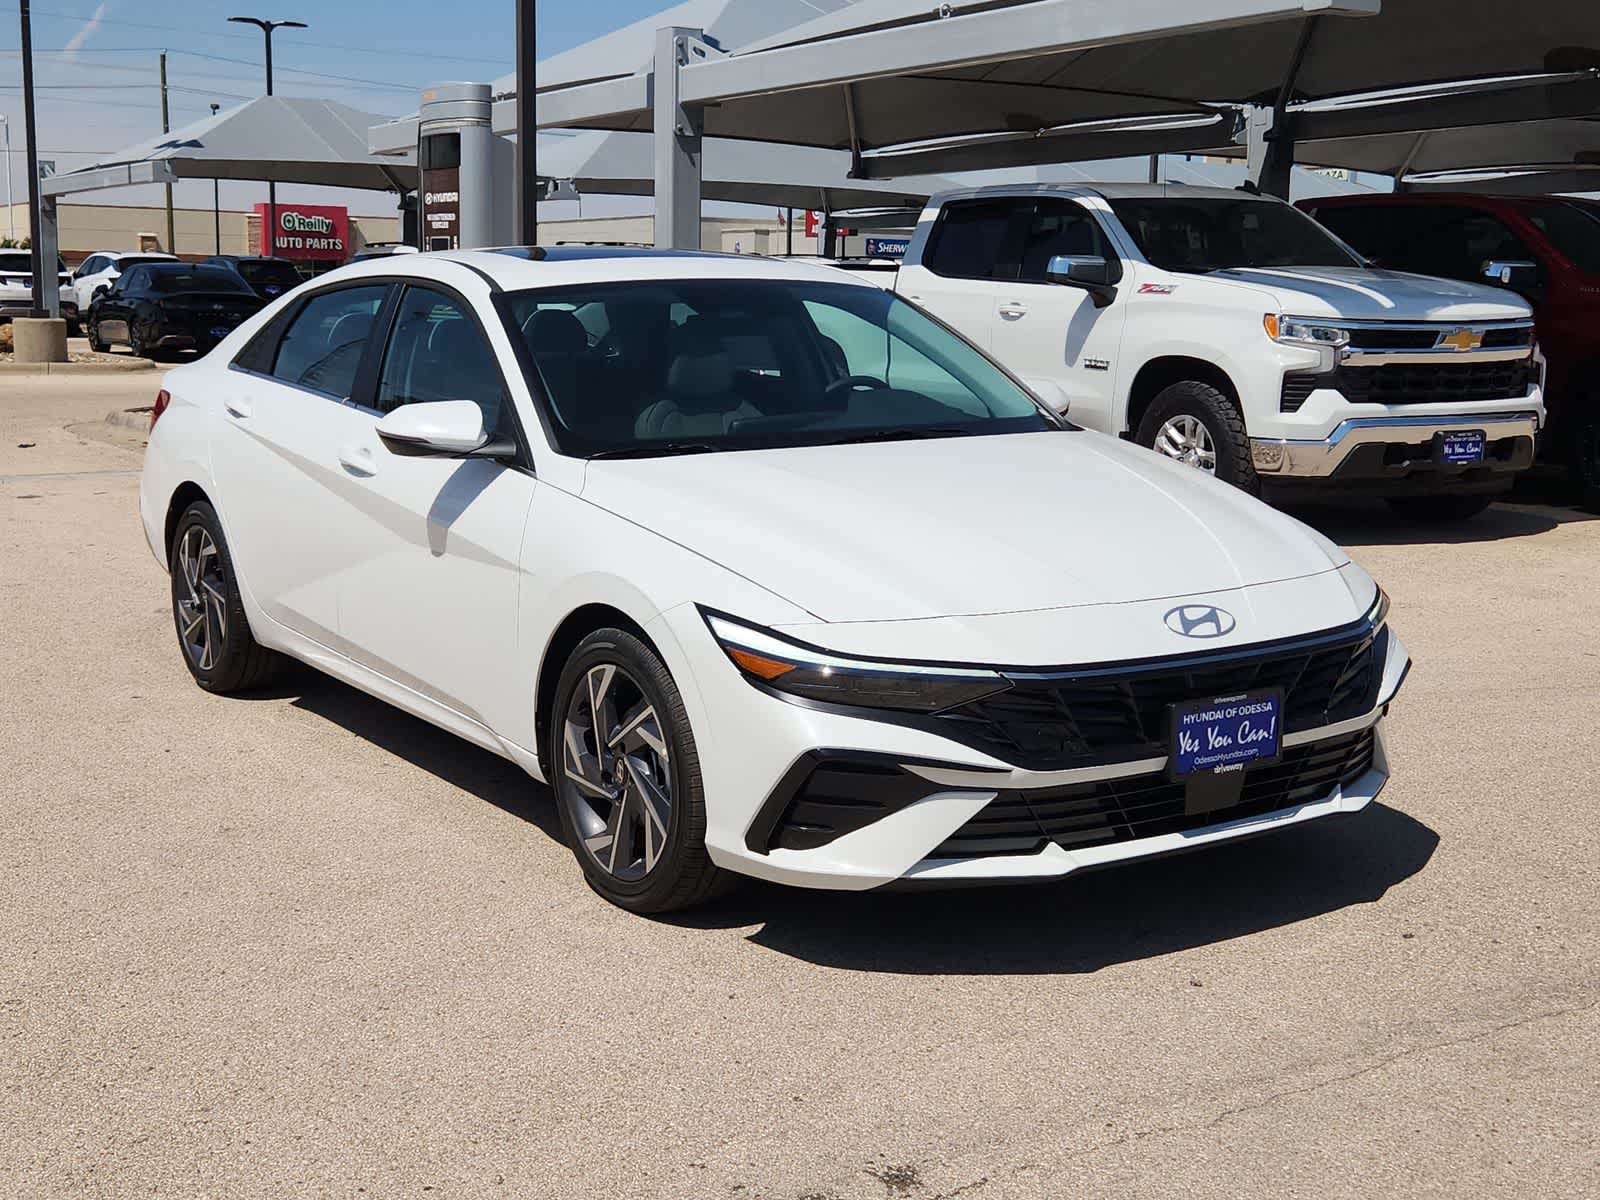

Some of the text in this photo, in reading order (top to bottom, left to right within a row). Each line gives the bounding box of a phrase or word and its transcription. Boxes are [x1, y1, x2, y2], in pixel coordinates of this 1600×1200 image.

[281, 212, 332, 233] O'Reilly
[306, 237, 343, 250] PARTS
[1183, 701, 1273, 725] HYUNDAI OF ODESSA
[1179, 716, 1276, 755] Yes You Can!
[1193, 748, 1259, 765] OdessaHyundai.com
[1213, 762, 1244, 774] driveway
